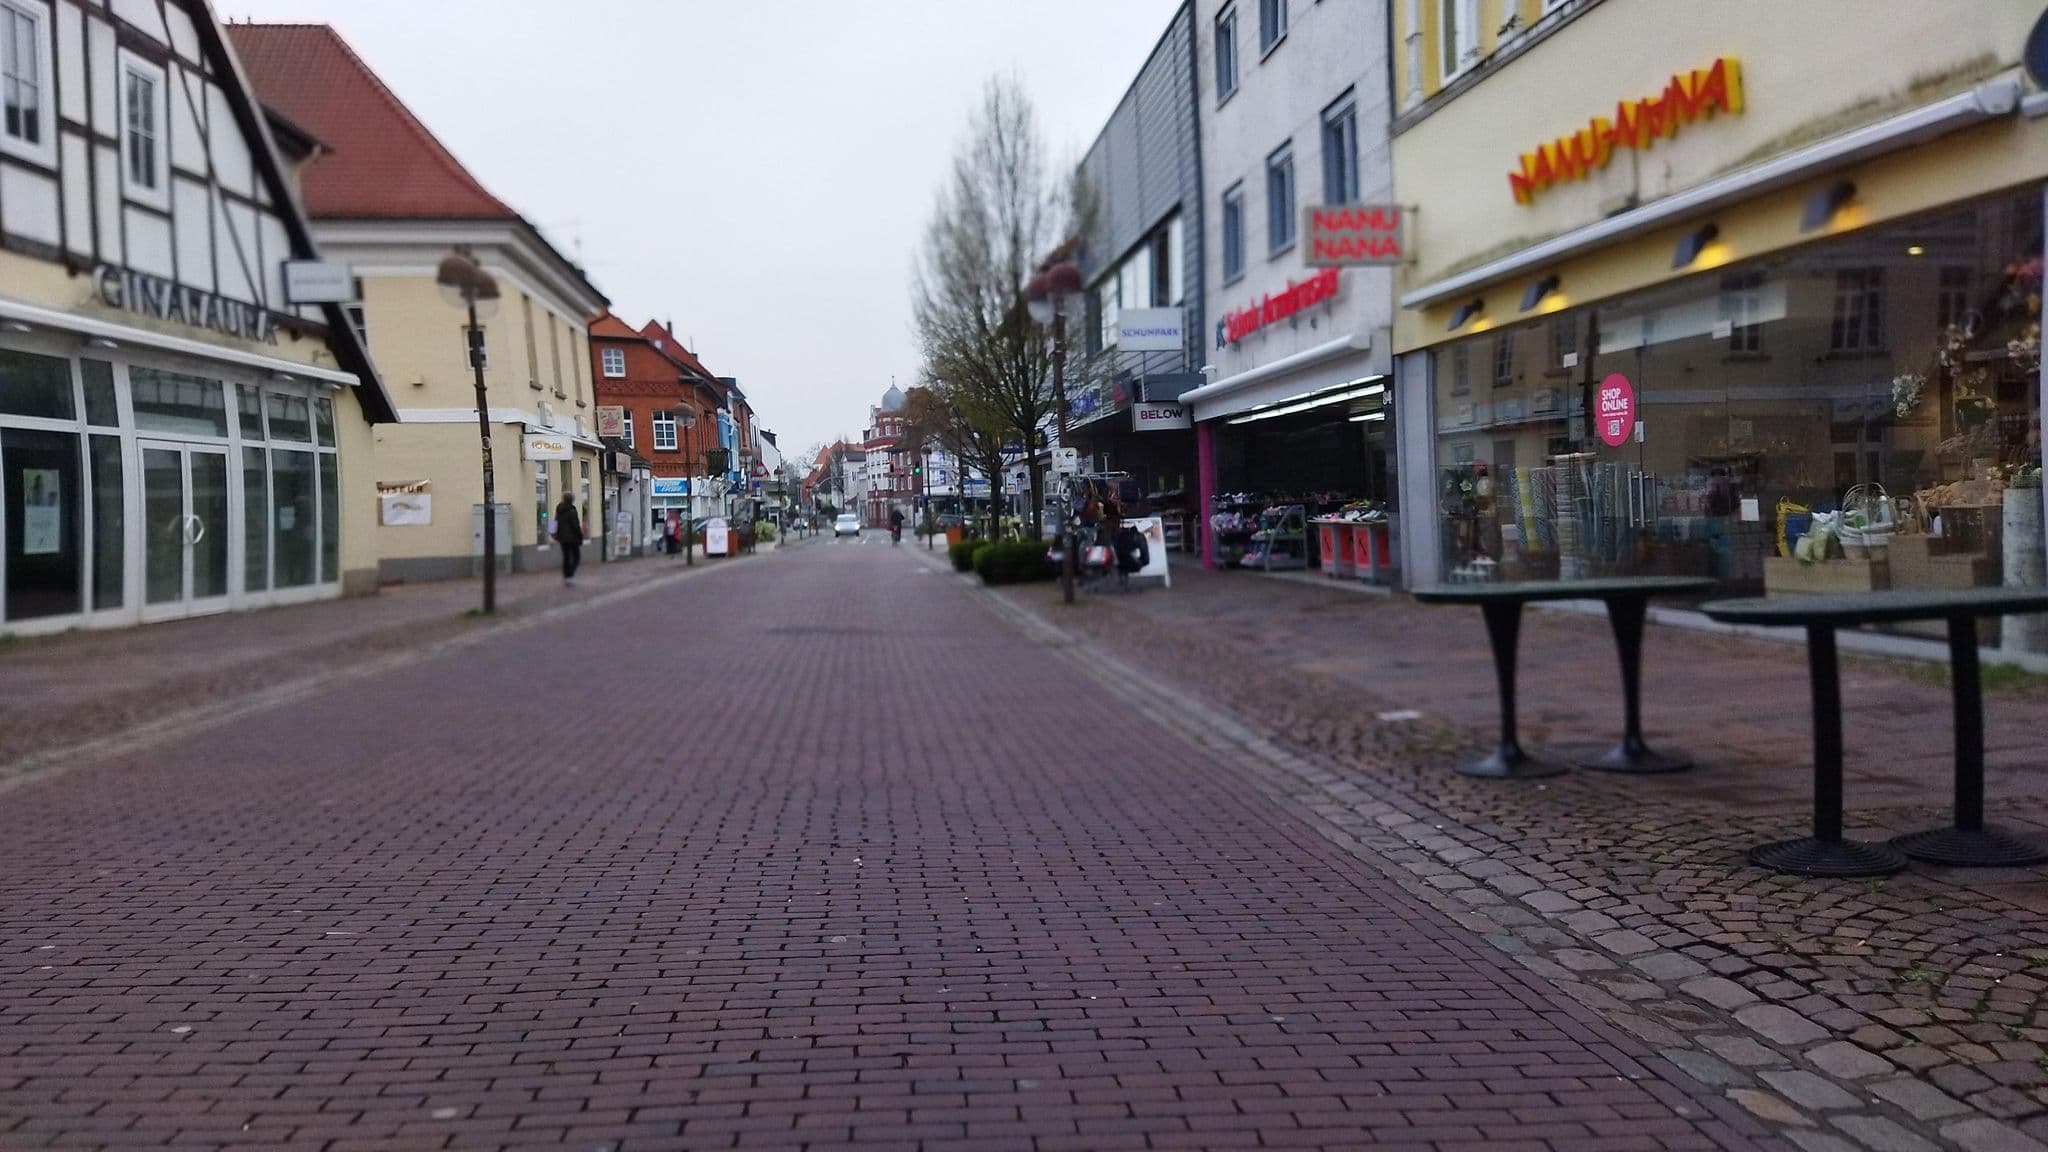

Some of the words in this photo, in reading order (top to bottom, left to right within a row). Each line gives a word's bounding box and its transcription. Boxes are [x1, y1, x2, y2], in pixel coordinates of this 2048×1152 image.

[1508, 57, 1743, 207] NANU-NANA
[1312, 207, 1401, 232] NANU
[1312, 235, 1402, 261] NANA
[1121, 328, 1179, 337] SCHUHPARK
[1602, 387, 1621, 401] SHOP
[1602, 398, 1628, 412] ONLINE
[1140, 409, 1184, 420] BELOW
